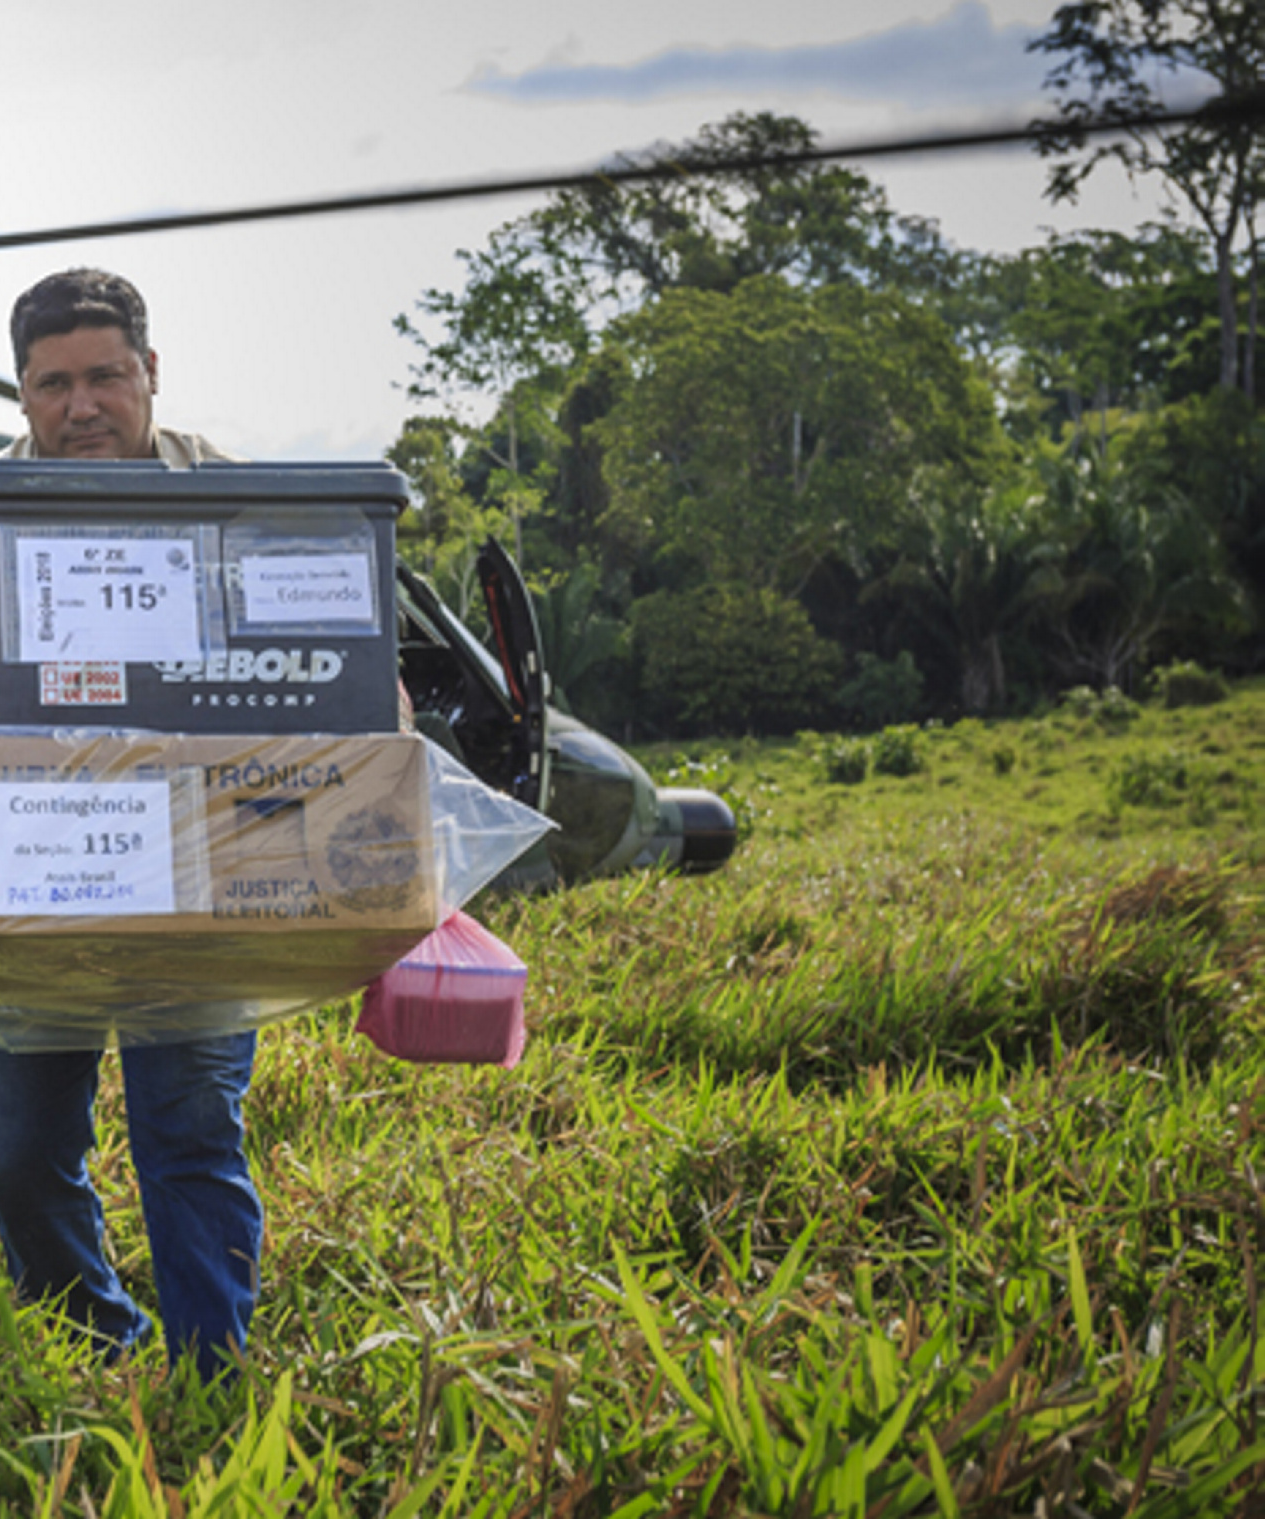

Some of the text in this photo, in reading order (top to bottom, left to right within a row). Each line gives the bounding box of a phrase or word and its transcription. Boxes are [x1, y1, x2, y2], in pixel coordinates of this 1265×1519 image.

[277, 586, 362, 604] Edmundo
[192, 694, 316, 706] PROCOMP
[9, 795, 147, 818] Contingência
[226, 879, 319, 899] JUSTIÇA
